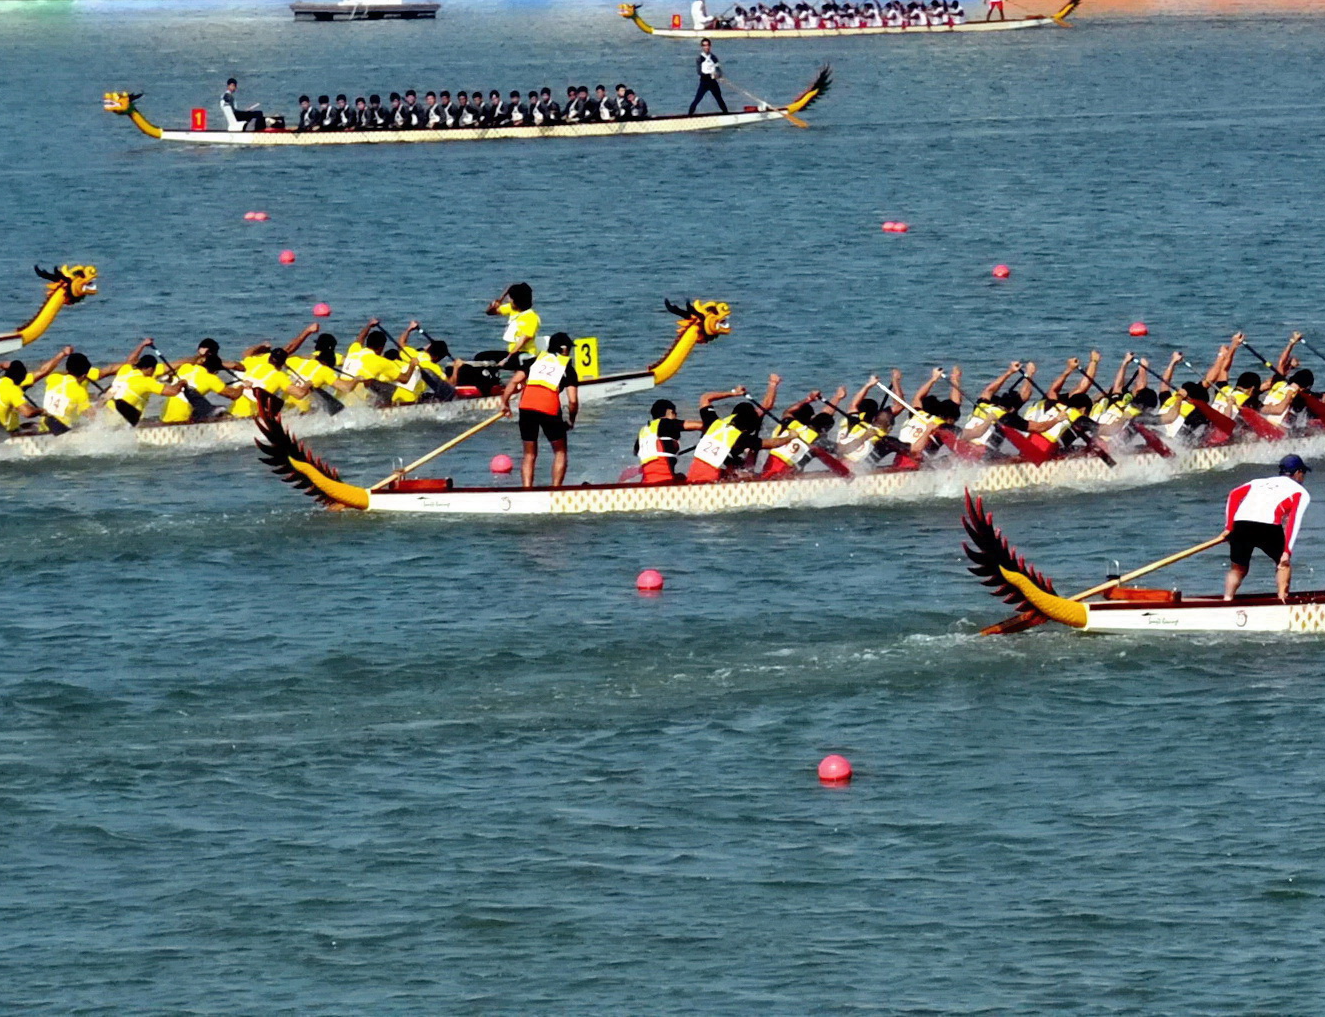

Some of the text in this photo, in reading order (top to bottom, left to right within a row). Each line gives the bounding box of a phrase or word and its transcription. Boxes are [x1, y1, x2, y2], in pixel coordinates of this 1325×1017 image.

[194, 111, 202, 126] 1
[581, 343, 592, 367] 3
[538, 364, 556, 377] 22
[702, 442, 721, 456] 24
